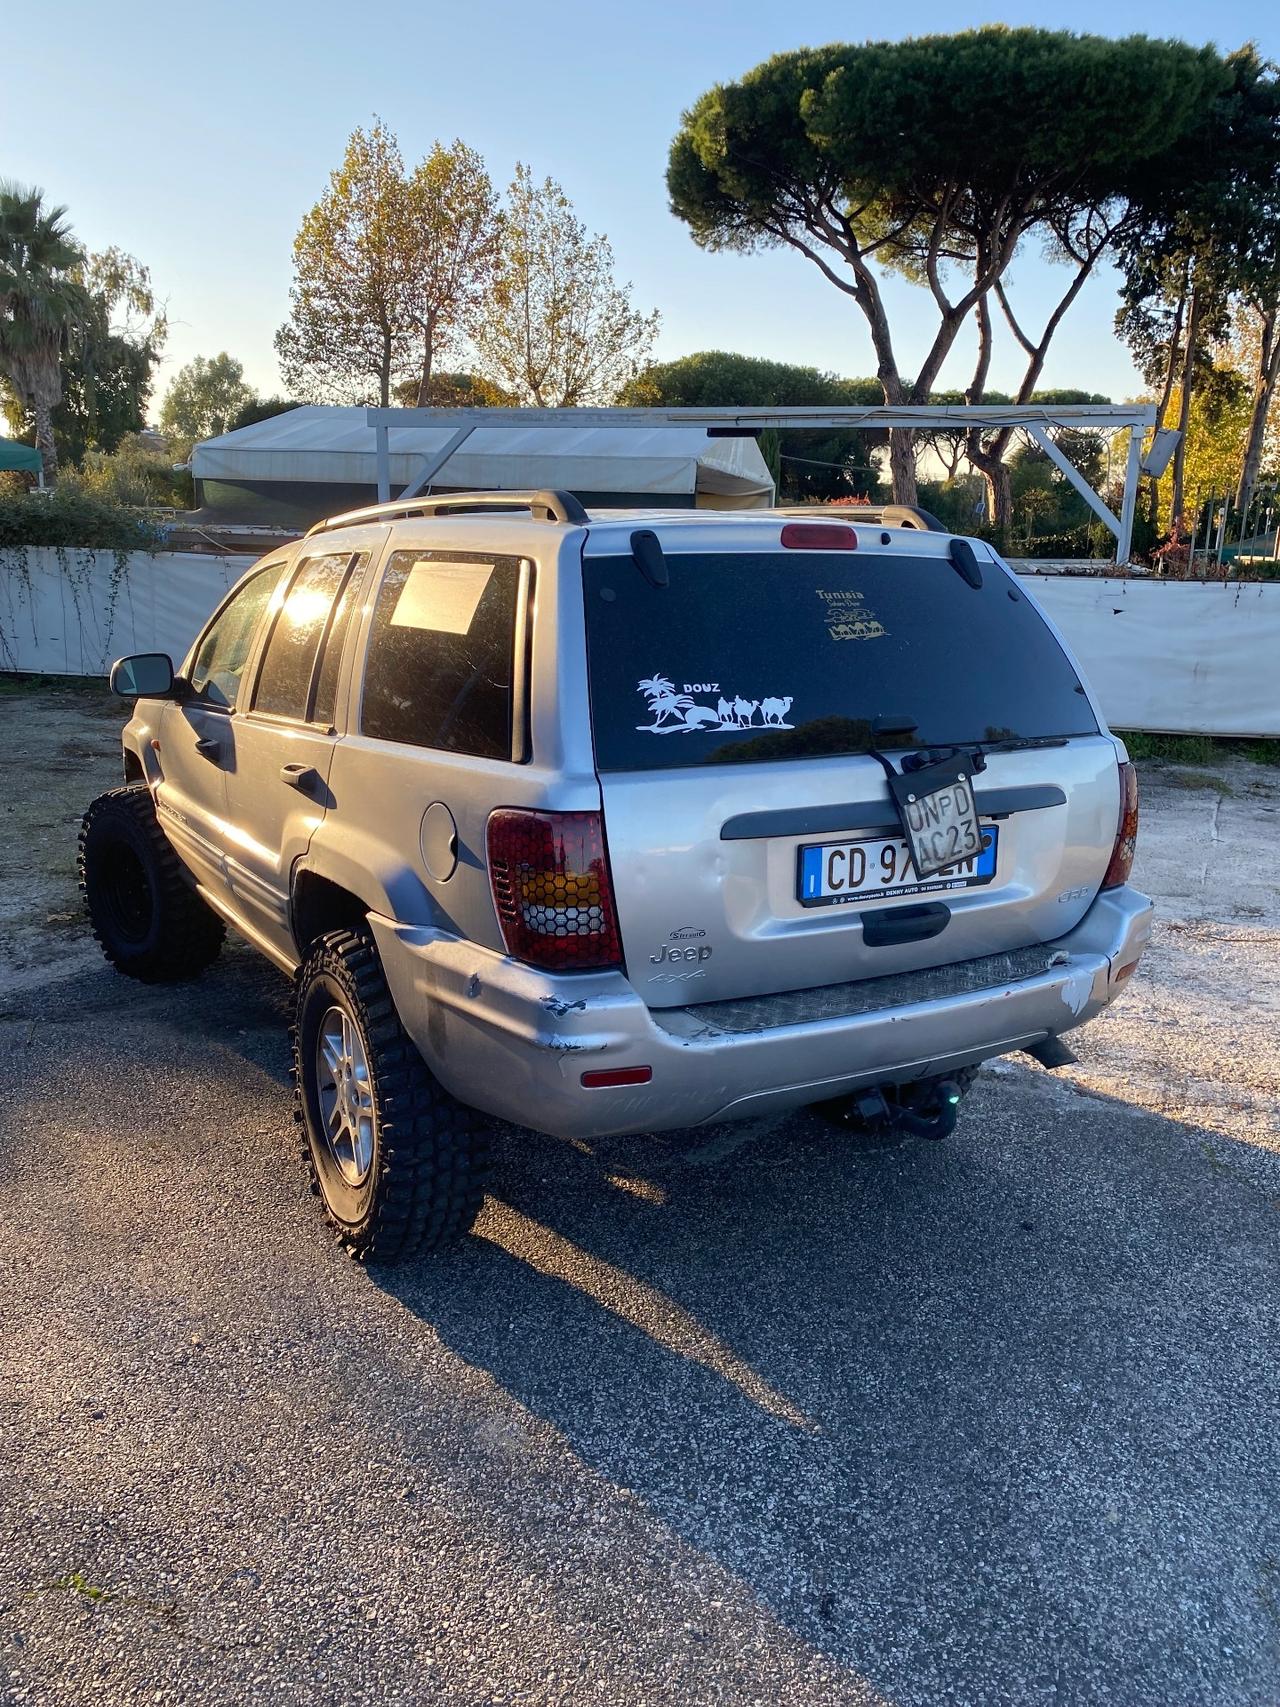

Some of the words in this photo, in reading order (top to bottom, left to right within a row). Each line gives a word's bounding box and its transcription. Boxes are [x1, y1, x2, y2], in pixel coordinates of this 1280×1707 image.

[815, 589, 864, 599] Tunisia
[683, 683, 721, 693] DOUZ
[917, 819, 977, 869] AC23
[827, 847, 867, 891] CD
[886, 888, 904, 896] DENNY
[904, 886, 919, 894] AUTO
[649, 944, 713, 965] Jeep
